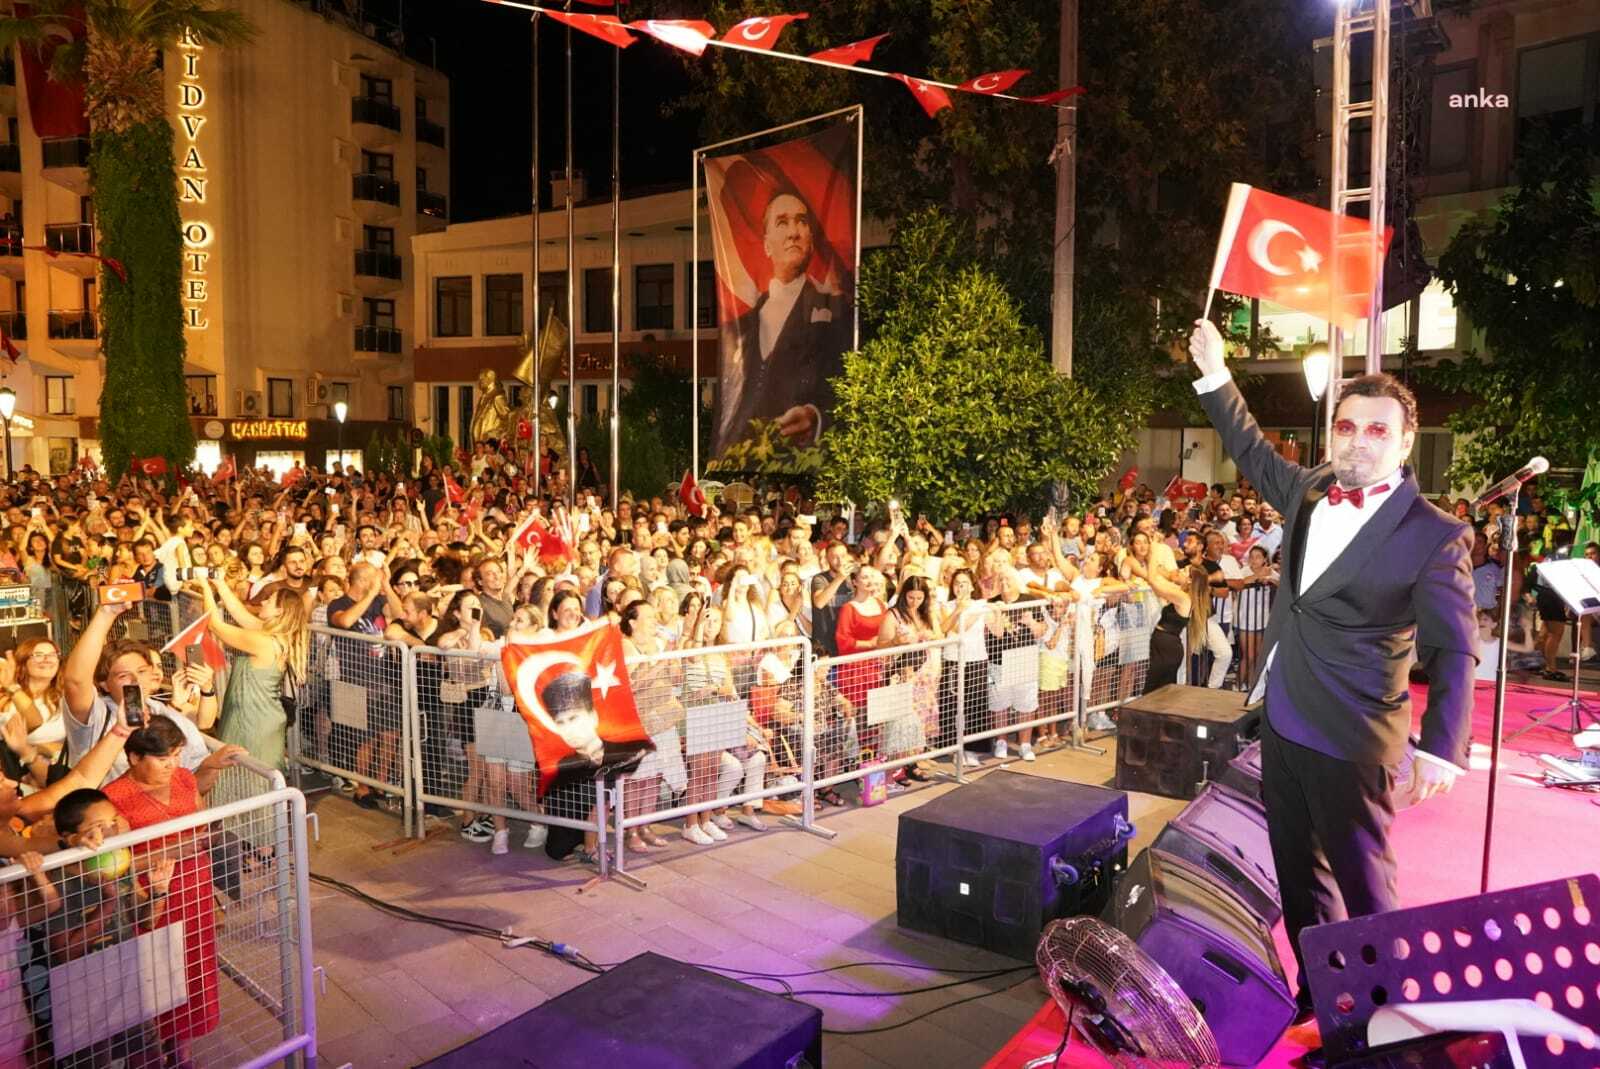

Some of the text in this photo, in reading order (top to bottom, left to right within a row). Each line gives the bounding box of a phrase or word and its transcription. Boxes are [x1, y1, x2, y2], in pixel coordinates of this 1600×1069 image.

[179, 25, 209, 329] RIDVAN OTEL
[231, 420, 307, 439] MANHATTAN
